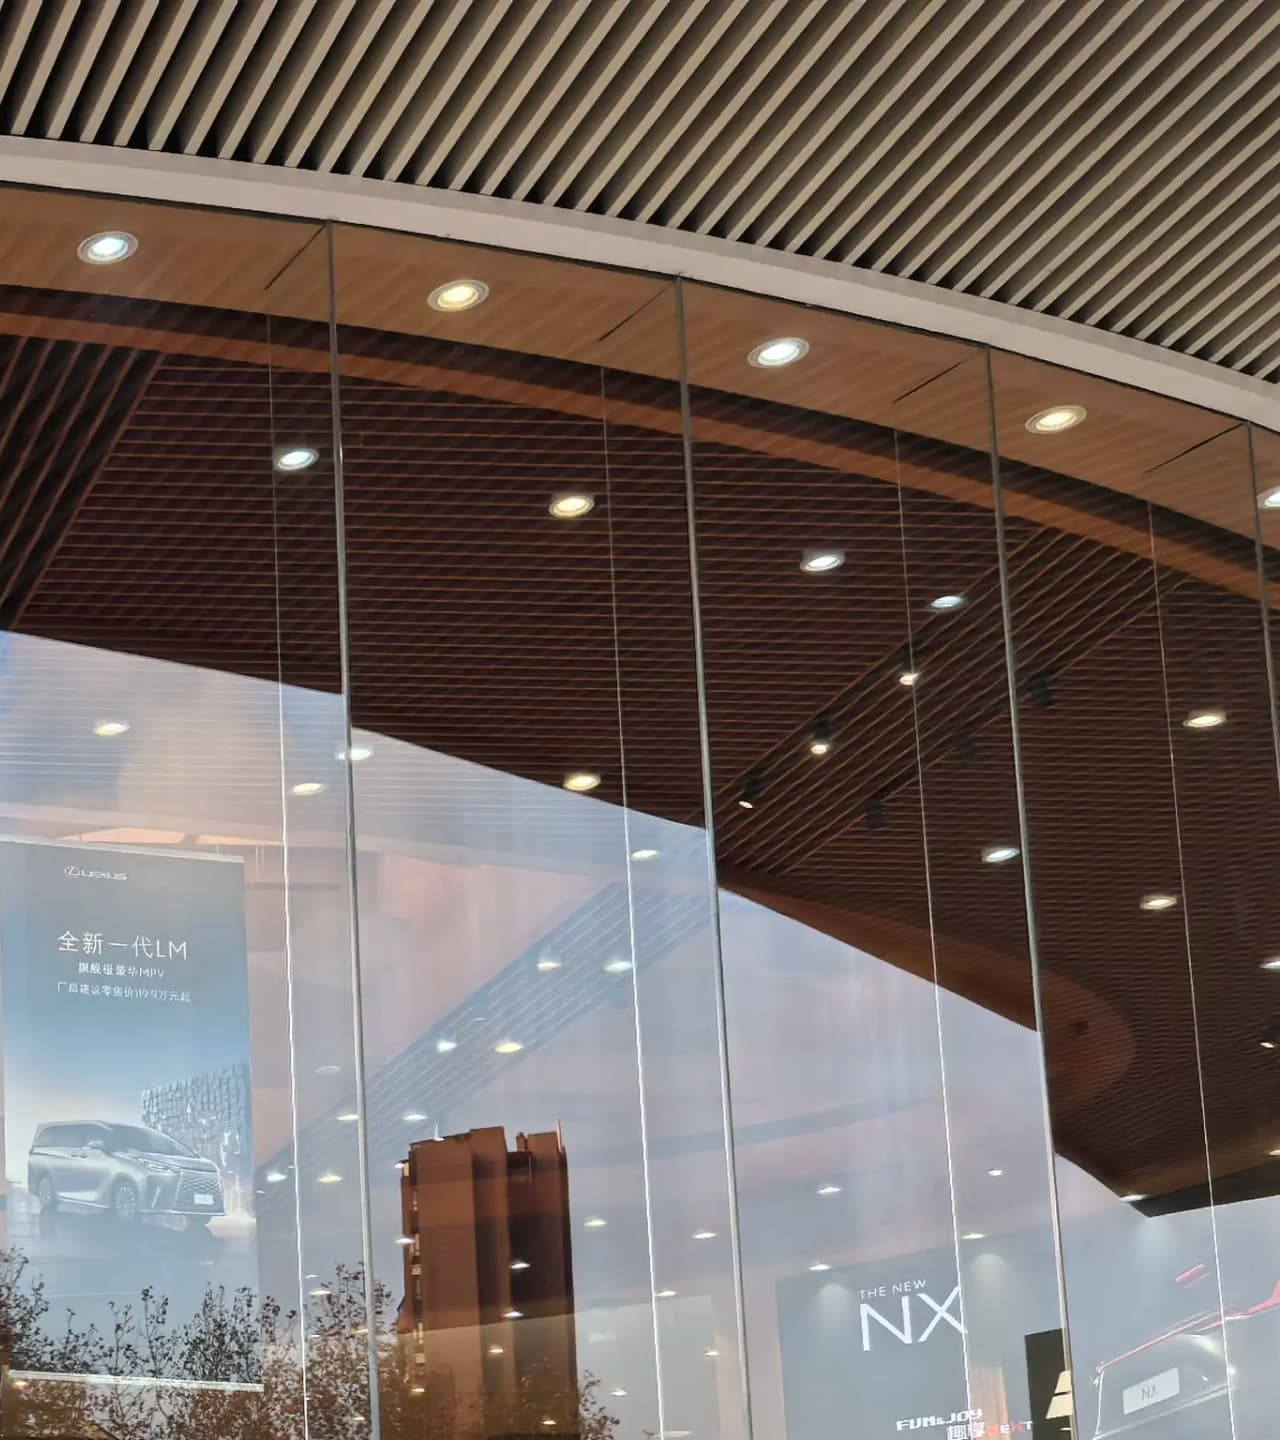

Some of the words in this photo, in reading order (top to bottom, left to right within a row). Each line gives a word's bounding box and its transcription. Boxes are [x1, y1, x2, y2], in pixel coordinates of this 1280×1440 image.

[81, 870, 128, 881] LEXUS
[57, 930, 188, 961] 全新一代LM
[860, 1286, 886, 1299] THE
[892, 1279, 927, 1295] NEW
[860, 1285, 968, 1351] NX
[896, 1408, 982, 1431] FUN&JOY
